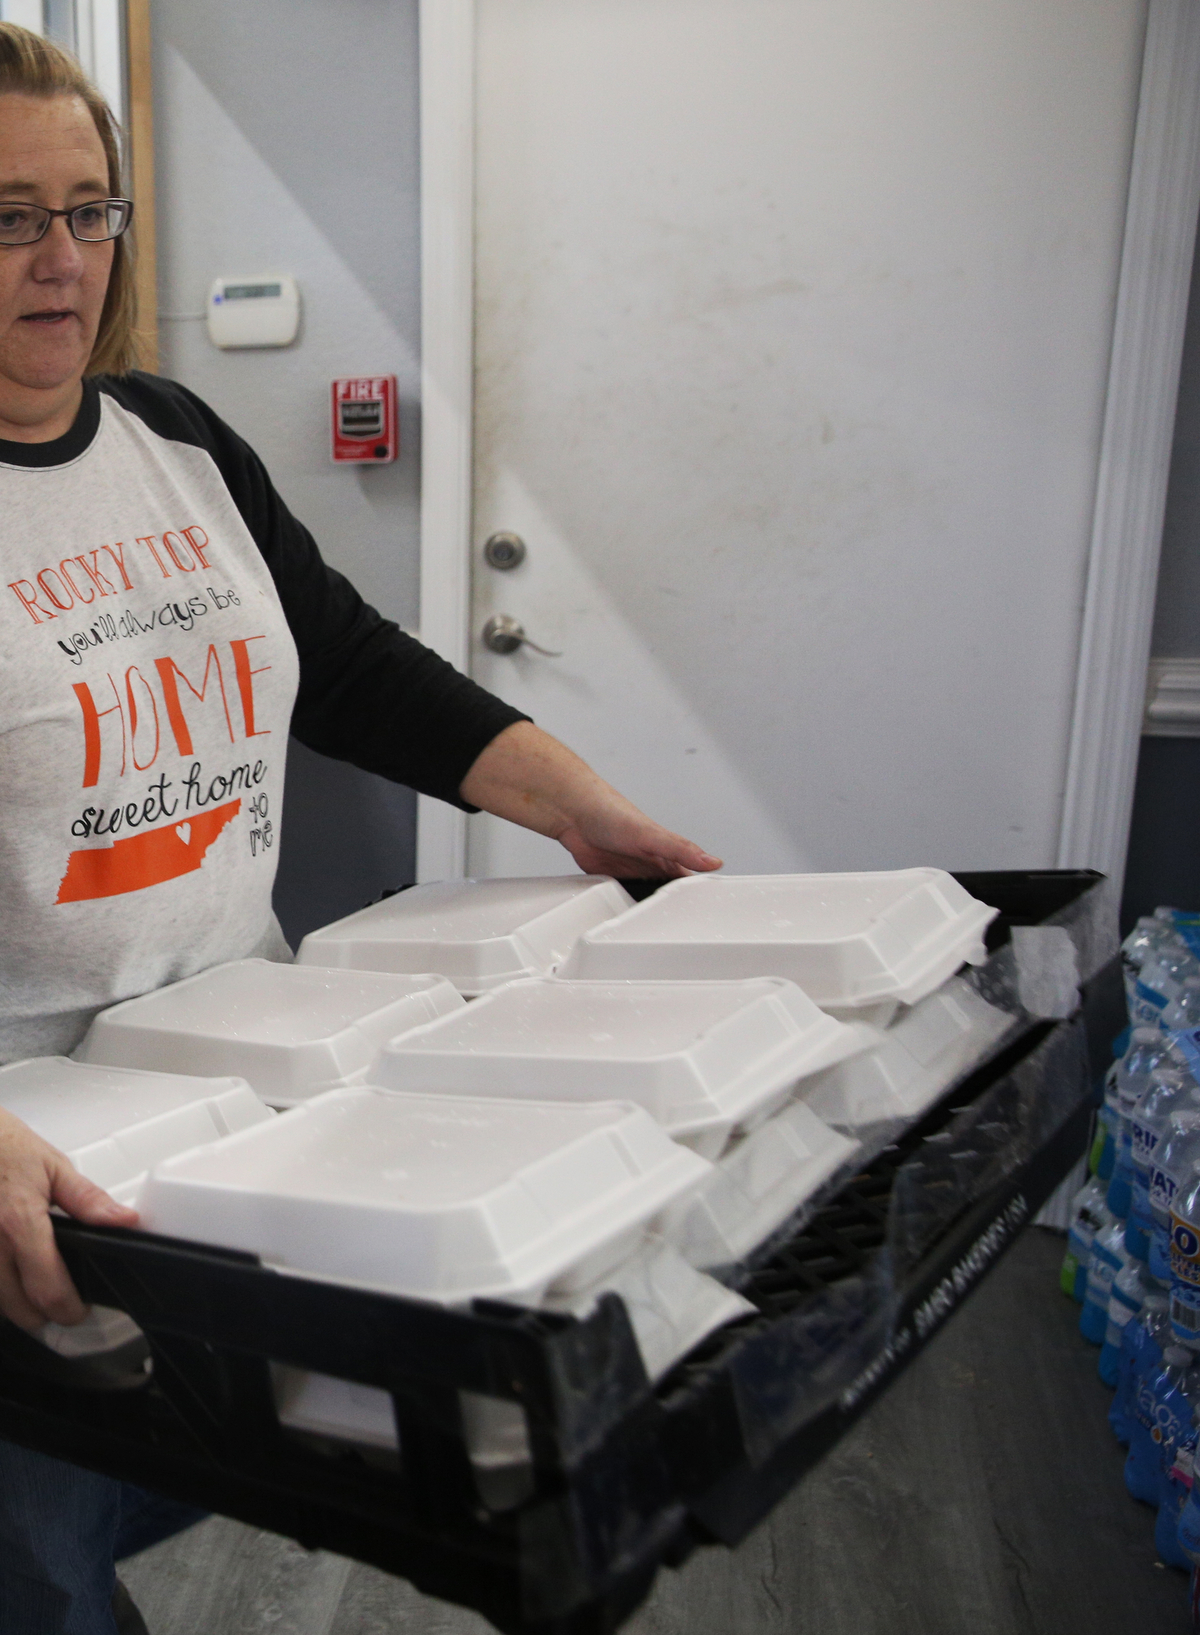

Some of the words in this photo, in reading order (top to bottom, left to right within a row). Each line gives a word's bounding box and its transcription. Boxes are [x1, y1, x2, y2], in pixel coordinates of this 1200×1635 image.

[337, 379, 384, 400] FIRE
[8, 542, 134, 625] ROCKY
[136, 525, 212, 579] TOP
[57, 612, 117, 665] you'll
[115, 595, 208, 638] always
[206, 586, 241, 611] be
[71, 634, 272, 789] HOME
[71, 772, 179, 838] sweet
[182, 760, 268, 811] home
[248, 792, 270, 822] to
[250, 820, 273, 857] me
